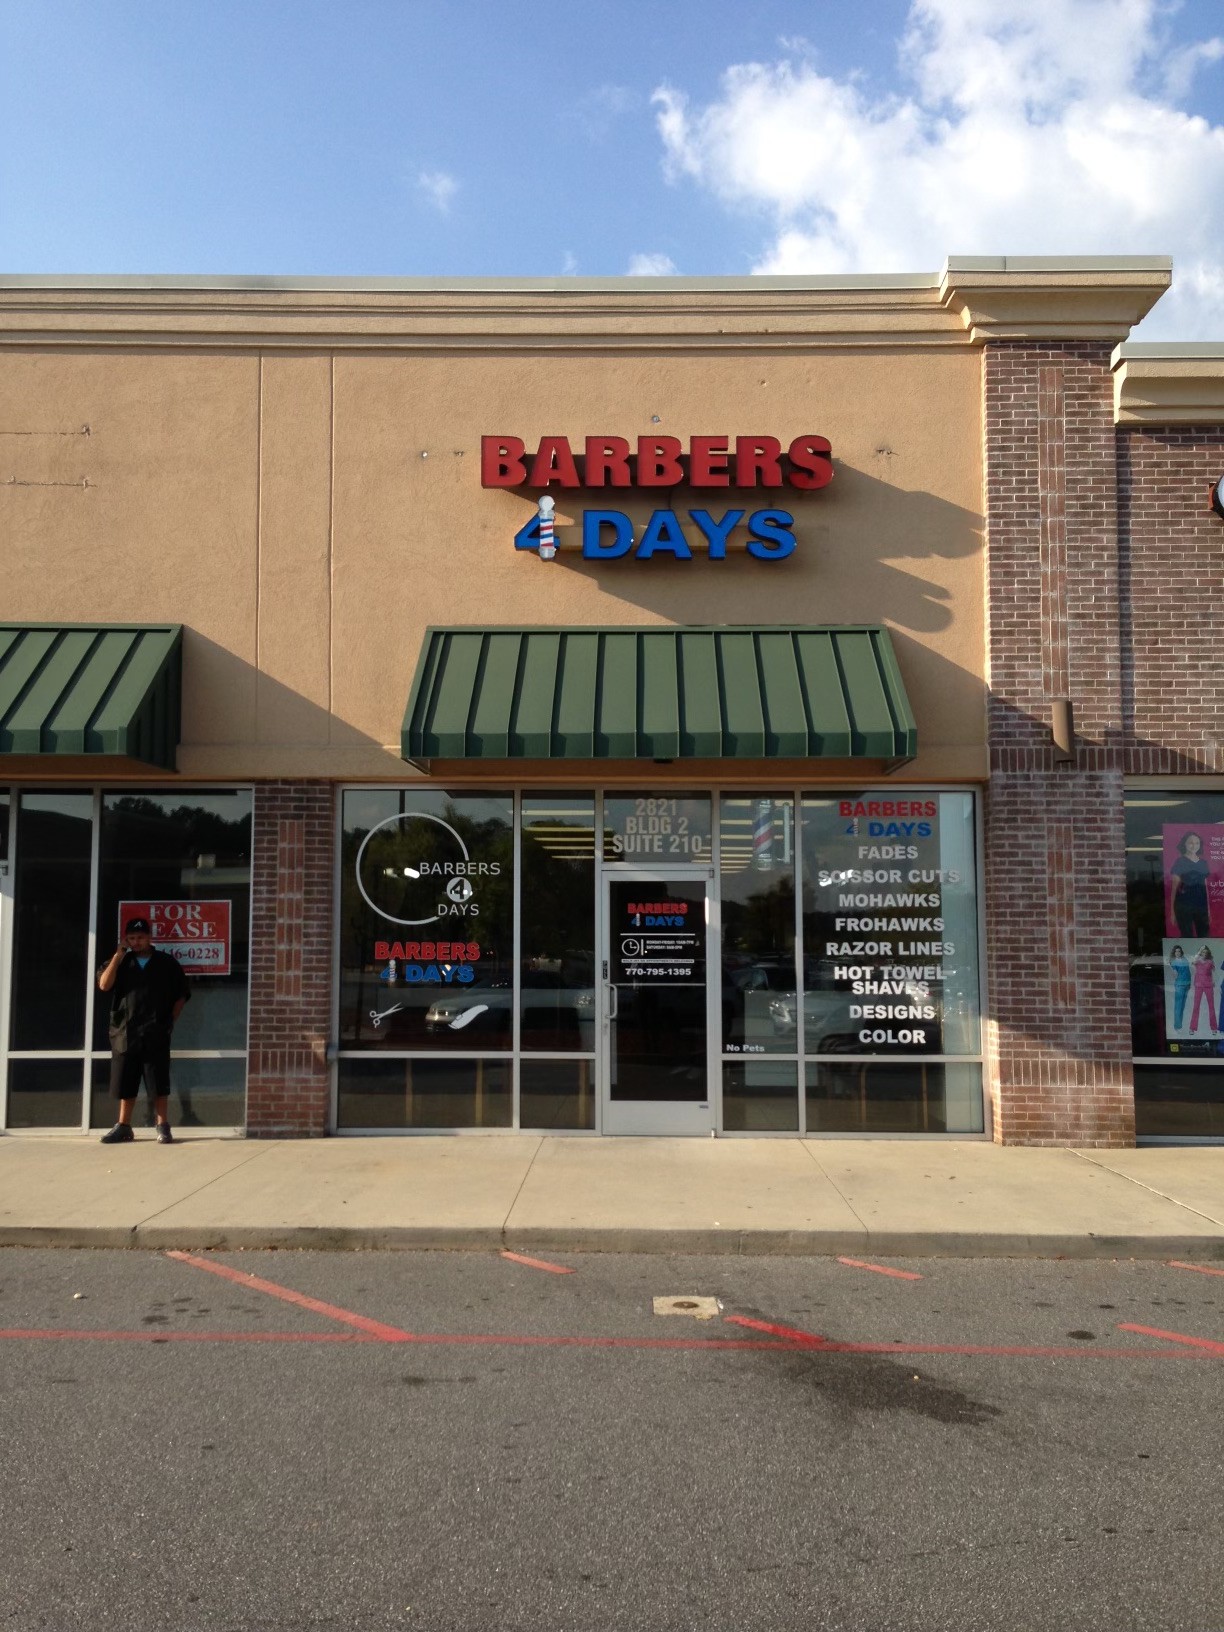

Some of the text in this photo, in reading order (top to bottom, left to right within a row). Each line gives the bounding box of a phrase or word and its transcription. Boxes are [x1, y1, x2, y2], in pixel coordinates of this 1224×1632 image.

[481, 435, 834, 489] BARBERS
[514, 508, 797, 561] 4 DAYS
[635, 799, 677, 816] 2821
[839, 801, 937, 817] BARBERS
[626, 817, 689, 834] BLDG 2
[869, 822, 932, 837] DAYS
[613, 835, 702, 853] SUITE 210
[858, 846, 918, 860] FADES
[420, 862, 500, 875] BARBERS
[818, 870, 960, 883] SCISSOR CUTS
[450, 878, 465, 900] 4
[839, 893, 941, 908] MOHAWKS
[149, 904, 202, 920] FOR
[438, 903, 480, 916] DAYS
[627, 903, 688, 914] BARBERS
[645, 915, 685, 927] DAYS
[835, 917, 945, 932] FROHAWKS
[149, 921, 217, 938] EASE
[375, 941, 480, 961] BARBERS
[826, 942, 955, 956] RAZOR LINES
[405, 964, 475, 983] DAYS
[625, 968, 691, 976] 770-795-1395
[834, 966, 947, 980] HOT TOWEL
[852, 981, 929, 995] SHAVES
[849, 1005, 936, 1020] DESIGNS
[858, 1029, 926, 1044] COLOR
[726, 1044, 765, 1052] No Pets
